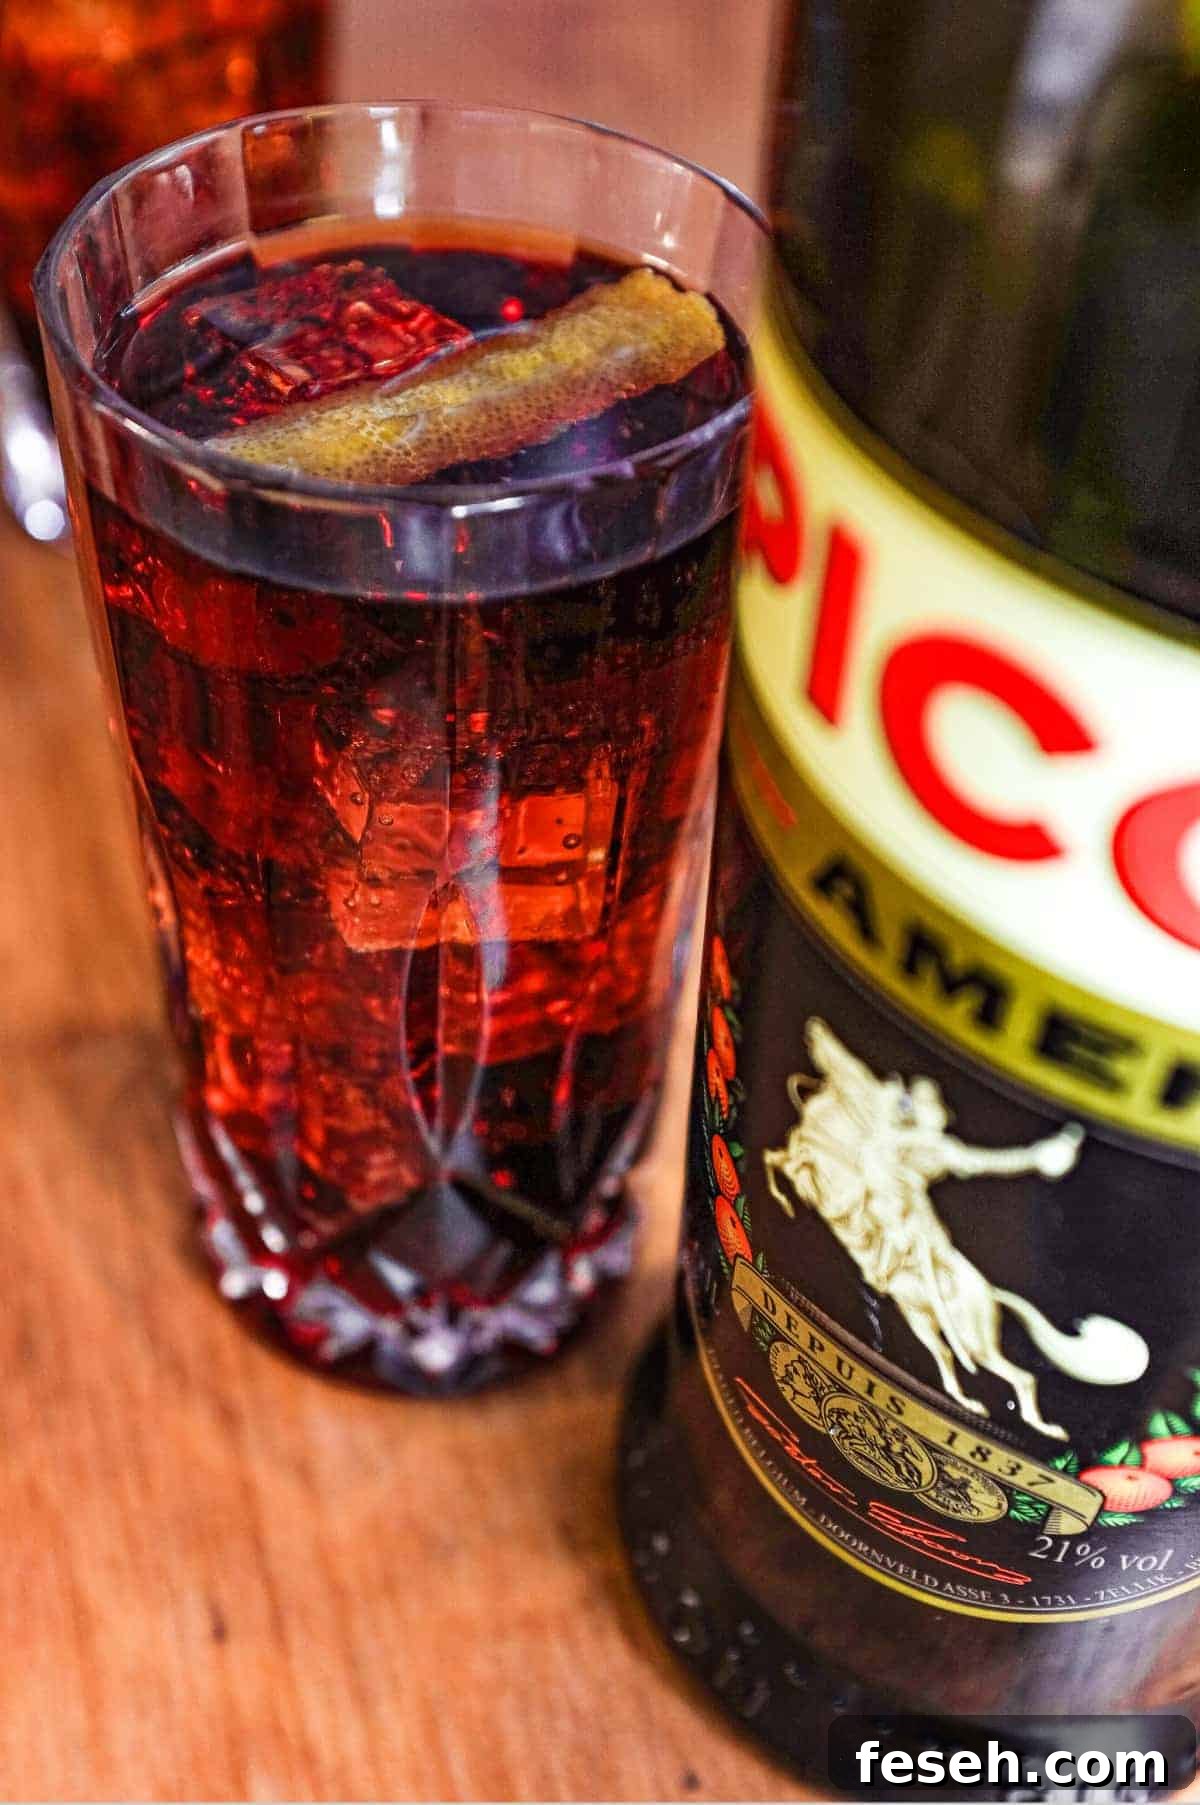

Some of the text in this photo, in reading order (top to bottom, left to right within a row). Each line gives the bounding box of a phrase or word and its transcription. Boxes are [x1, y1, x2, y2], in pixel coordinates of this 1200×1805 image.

[761, 1289, 906, 1416] DEPUIS
[943, 1431, 1055, 1487] 1837
[818, 1512, 939, 1589] DOORNVELD
[943, 1582, 993, 1602] ASSE
[999, 1593, 1010, 1606] 3
[1031, 1594, 1077, 1608] 1731
[1028, 1535, 1108, 1570] 21%
[1120, 1549, 1175, 1572] vol
